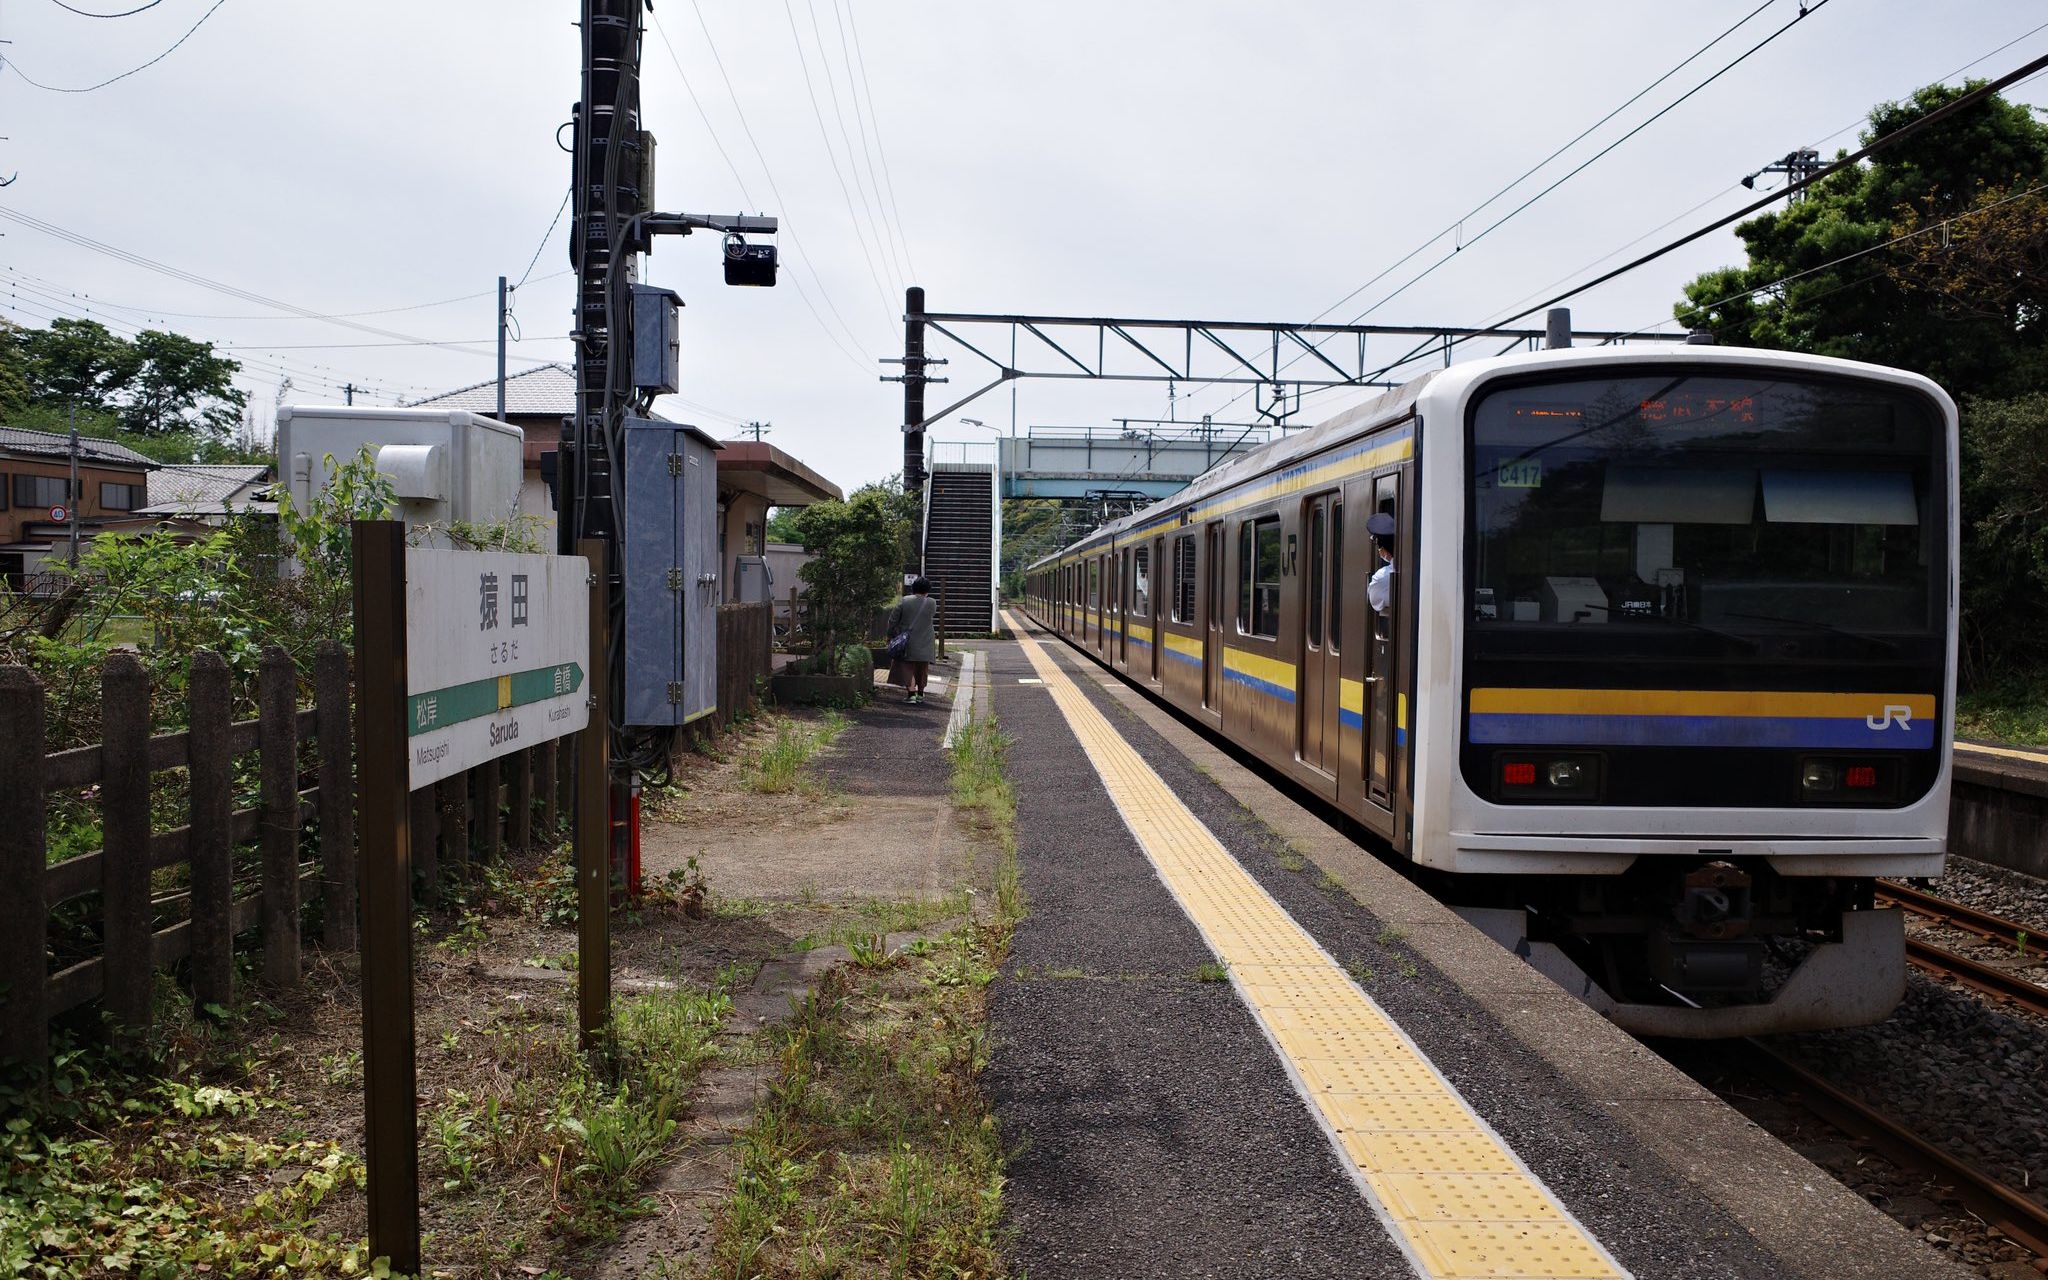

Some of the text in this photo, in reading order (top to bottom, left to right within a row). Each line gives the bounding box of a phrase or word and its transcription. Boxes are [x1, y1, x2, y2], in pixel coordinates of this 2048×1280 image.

[1500, 464, 1540, 485] C417
[1282, 534, 1297, 576] JR
[480, 572, 528, 631] 猿田
[491, 640, 519, 664] さるだ
[554, 665, 571, 693] 倉橋
[417, 697, 437, 728] 松岸
[549, 704, 570, 722] Kurahashi
[1866, 704, 1912, 730] JR
[490, 717, 519, 747] Saruda
[416, 741, 450, 765] Matsugishi
